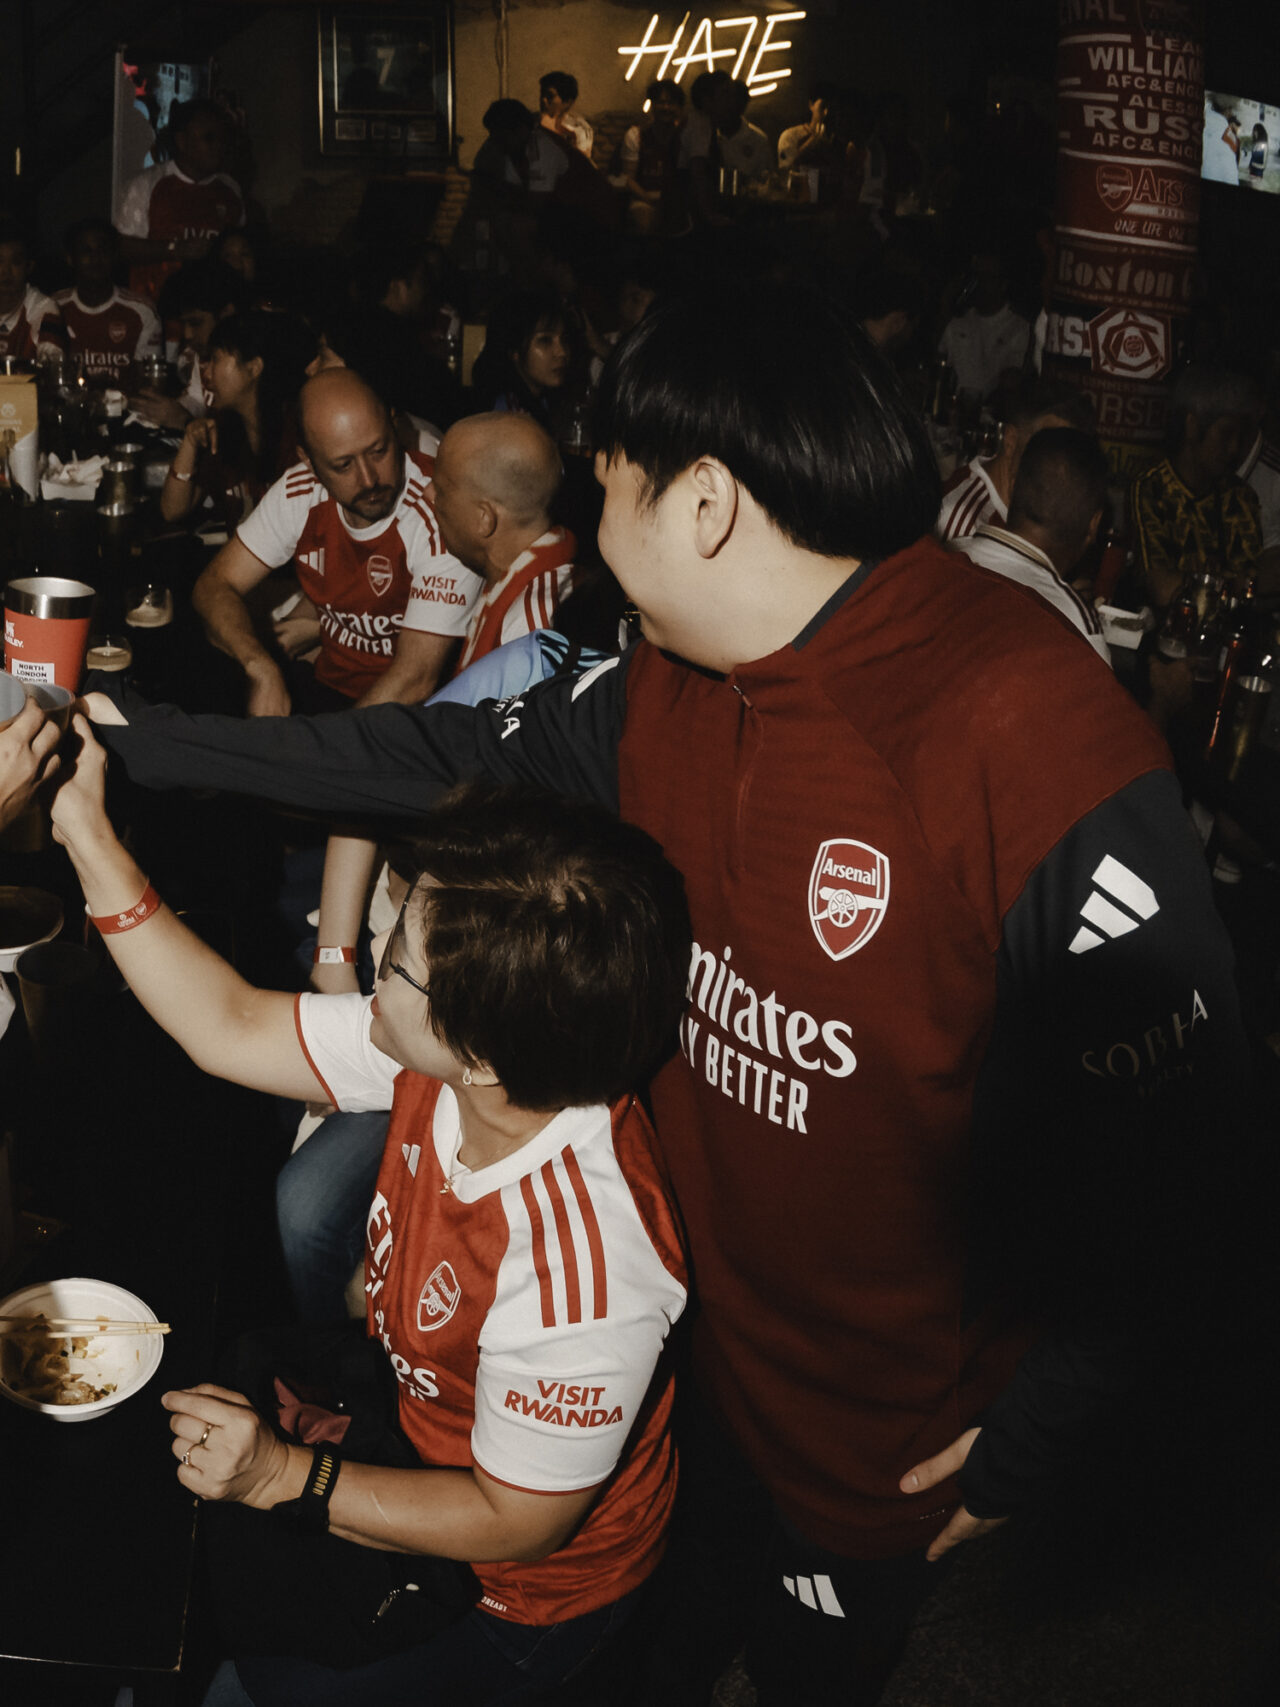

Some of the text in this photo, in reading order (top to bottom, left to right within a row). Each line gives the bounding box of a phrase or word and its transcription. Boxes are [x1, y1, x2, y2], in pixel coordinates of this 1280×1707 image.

[422, 575, 457, 590] VISIT
[410, 587, 467, 606] RWANDA
[16, 670, 47, 678] LONDON
[19, 663, 45, 671] NORTH
[822, 857, 877, 886] Arsenal
[686, 942, 858, 1078] mirates
[705, 1033, 809, 1134] BETTER
[537, 1380, 606, 1406] VISIT
[504, 1390, 624, 1428] RWANDA
